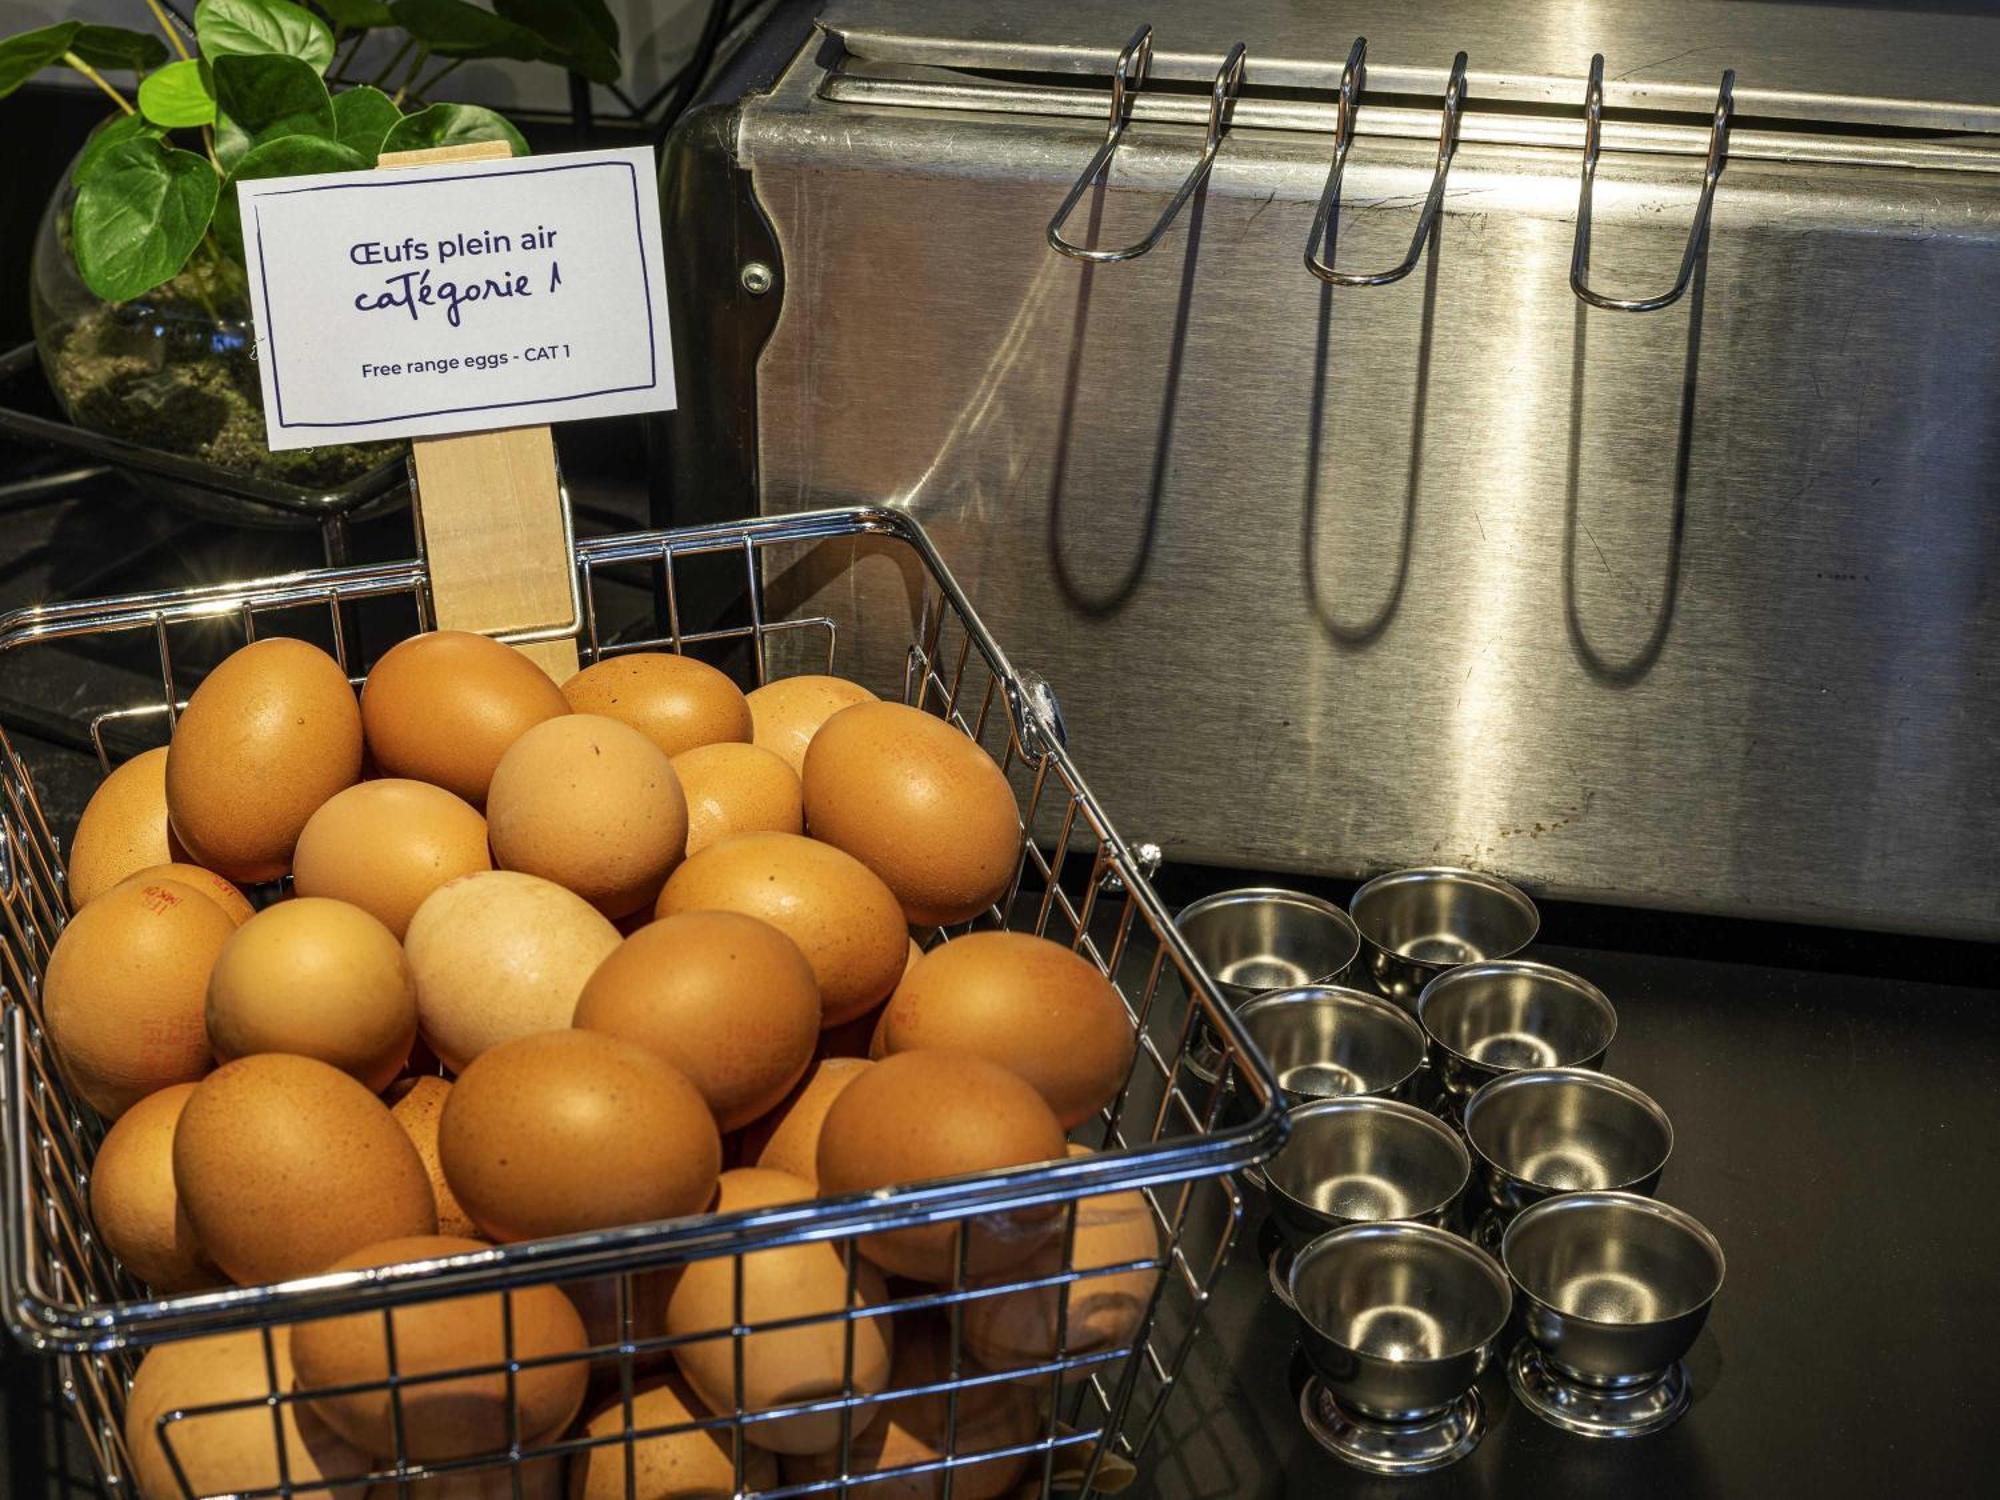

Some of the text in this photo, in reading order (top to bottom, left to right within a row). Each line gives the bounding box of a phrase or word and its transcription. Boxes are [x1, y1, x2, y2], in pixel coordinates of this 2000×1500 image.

[350, 225, 558, 266] Œufs plein air
[550, 261, 563, 293] 1
[361, 363, 402, 378] Free
[407, 358, 460, 374] range
[464, 353, 509, 370] eggs
[524, 345, 560, 362] CAT
[562, 344, 571, 358] 1
